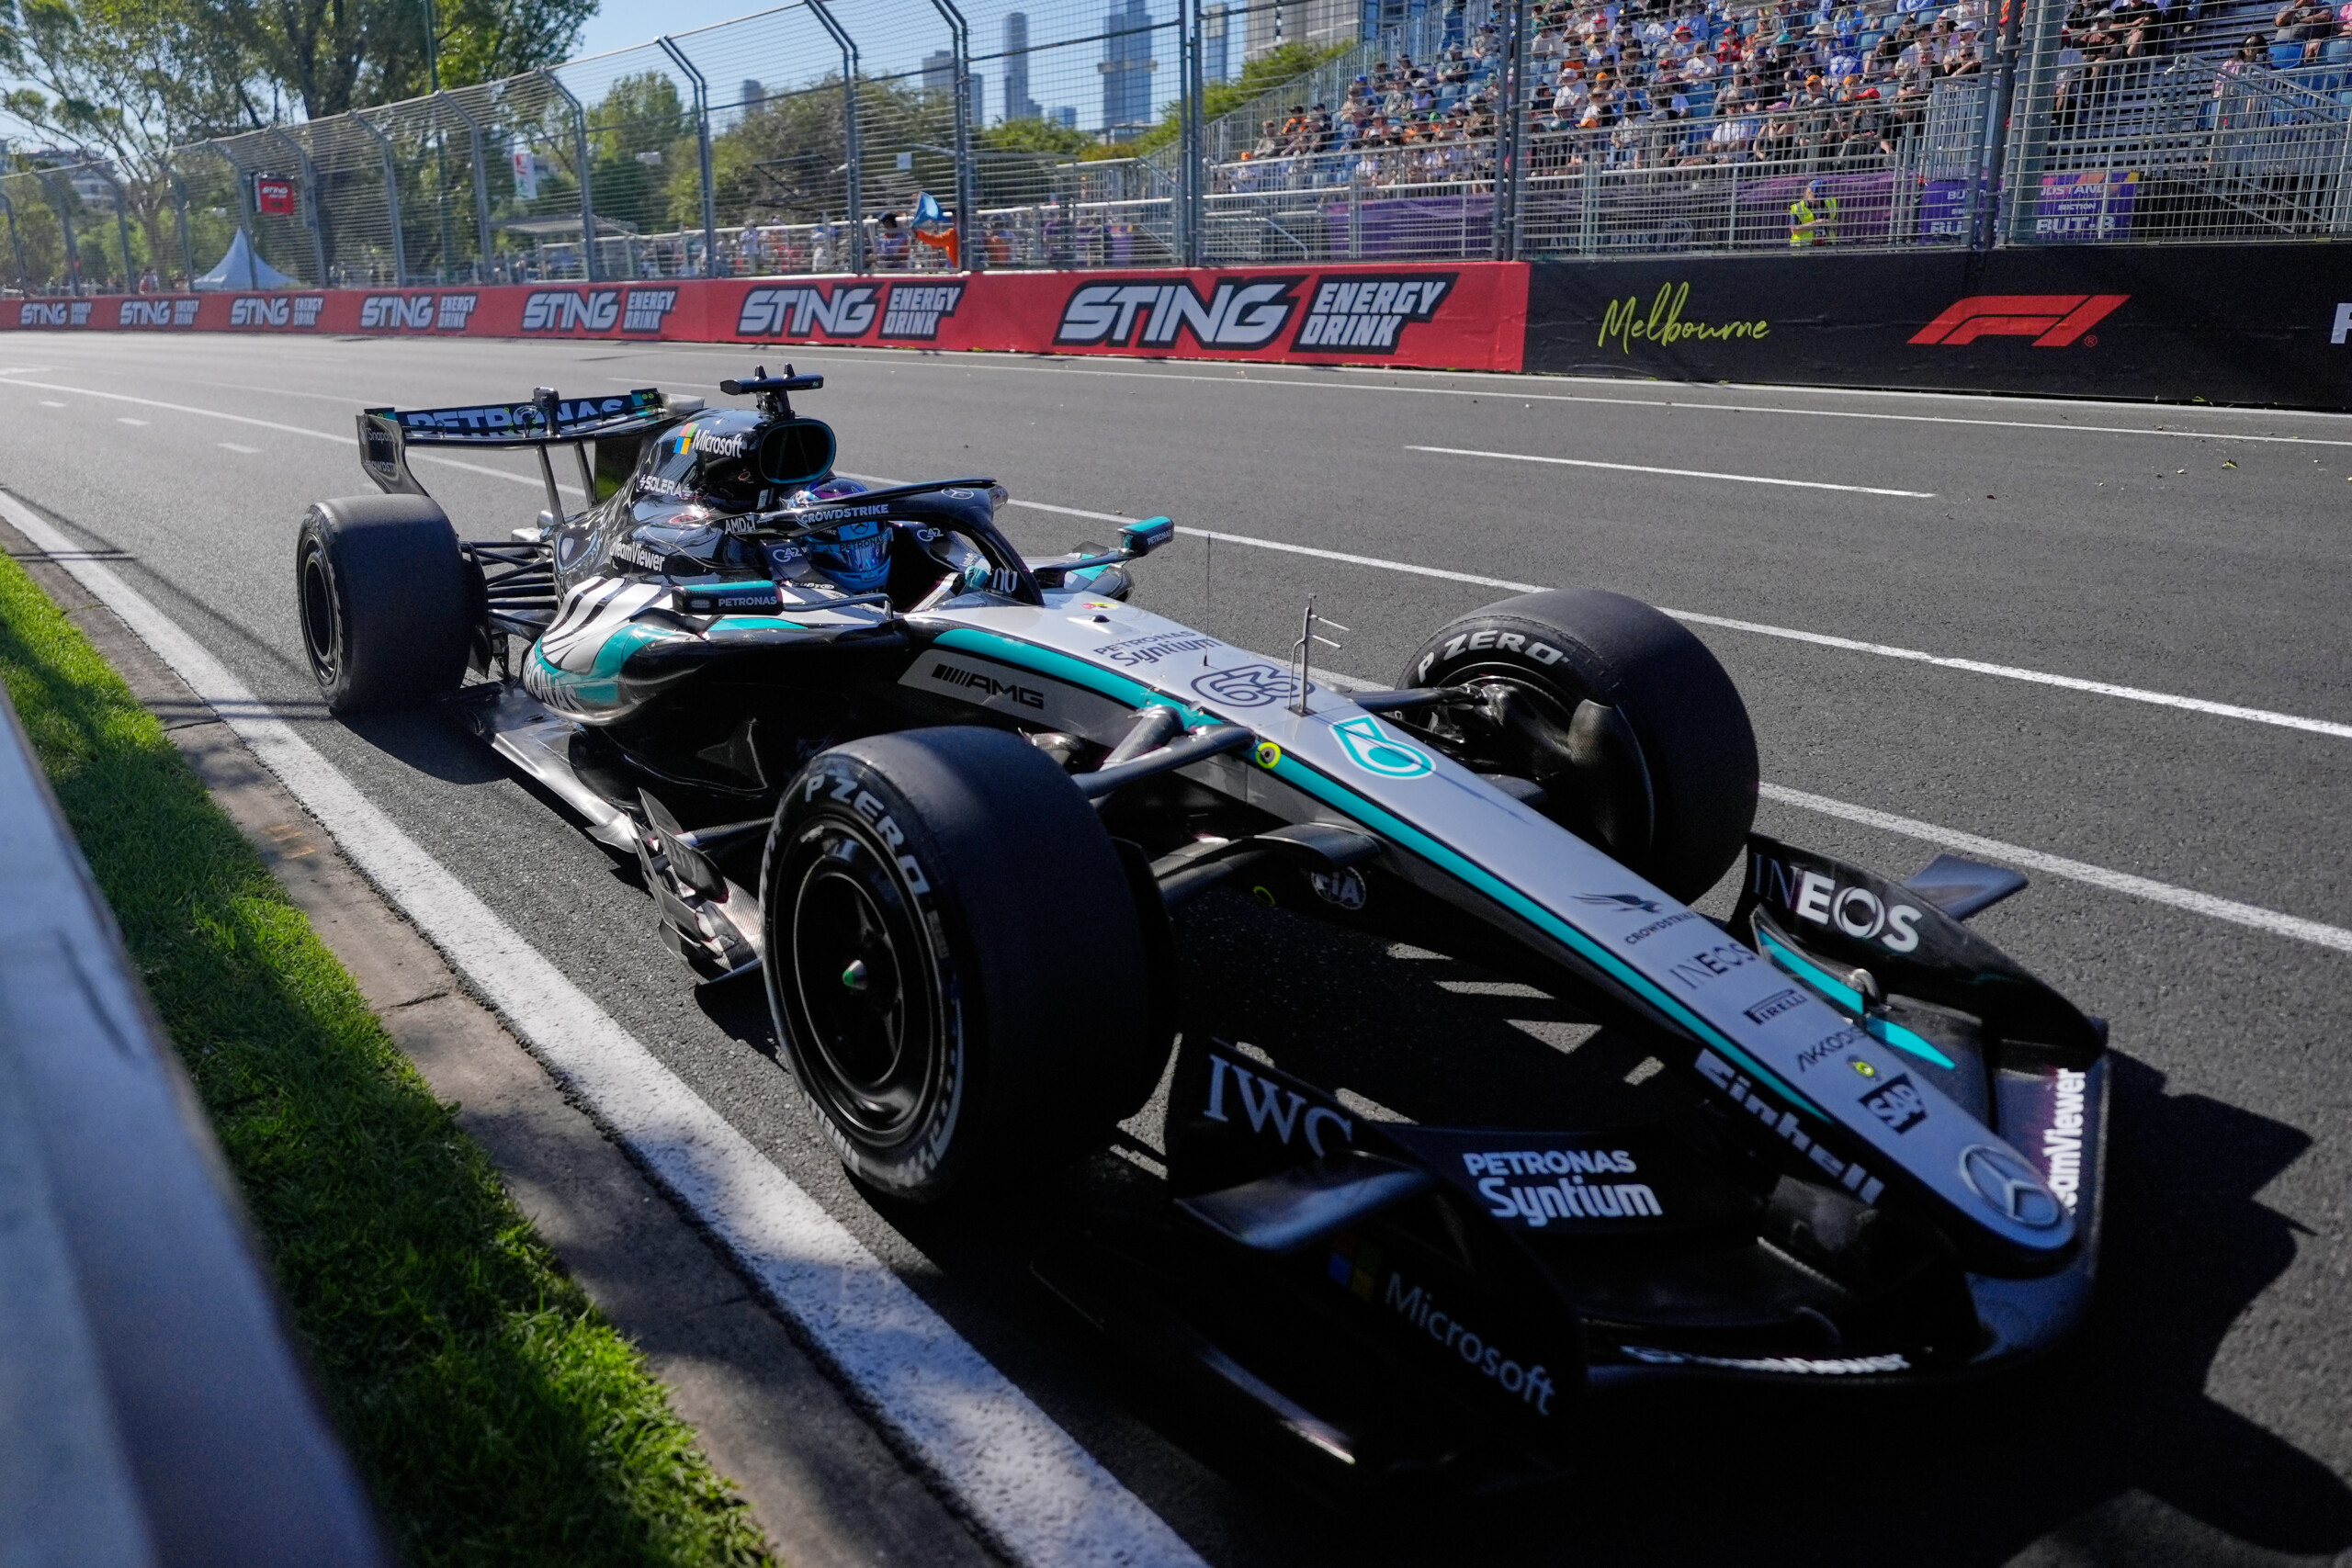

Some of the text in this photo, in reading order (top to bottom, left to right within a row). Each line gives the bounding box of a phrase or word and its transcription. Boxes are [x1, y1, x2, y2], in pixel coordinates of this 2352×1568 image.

[119, 300, 172, 325] STING
[231, 298, 290, 325] STING
[360, 296, 435, 327] STING
[440, 296, 477, 312] ENERGY
[522, 291, 620, 331] STING
[627, 290, 675, 310] ENERGY
[739, 288, 877, 335] STING
[888, 287, 961, 311] ENERGY
[1313, 281, 1446, 314] ENERGY
[20, 302, 67, 325] STING
[437, 312, 467, 328] DRINK
[623, 310, 662, 330] DRINK
[882, 311, 940, 335] DRINK
[1059, 283, 1290, 344] STING
[1598, 281, 1770, 355] Melbourne
[1299, 315, 1404, 347] DRINK
[692, 429, 743, 458] Microsoft
[643, 475, 683, 498] SOLERA
[725, 516, 747, 535] AMD
[801, 504, 889, 525] CROWDSTRIKE
[840, 535, 885, 551] PETRONAS
[1147, 529, 1172, 546] PETRONAS
[718, 596, 777, 607] PETRONAS
[1093, 630, 1197, 655] PETRONAS
[1110, 637, 1223, 667] Syntium
[1418, 630, 1564, 683] P ZERO
[964, 671, 1045, 710] AMG
[805, 774, 931, 895] P ZERO
[1753, 852, 1923, 953] INEOS
[1668, 942, 1758, 990] INEOS
[1744, 988, 1809, 1026] PIRELLI
[1203, 1053, 1354, 1157] IWC
[1694, 1048, 1885, 1205] Einhell
[2042, 1068, 2086, 1215] eamViewer
[1463, 1150, 1637, 1178] PETRONAS
[1477, 1177, 1664, 1227] Syntium
[1385, 1271, 1555, 1416] Microsoft
